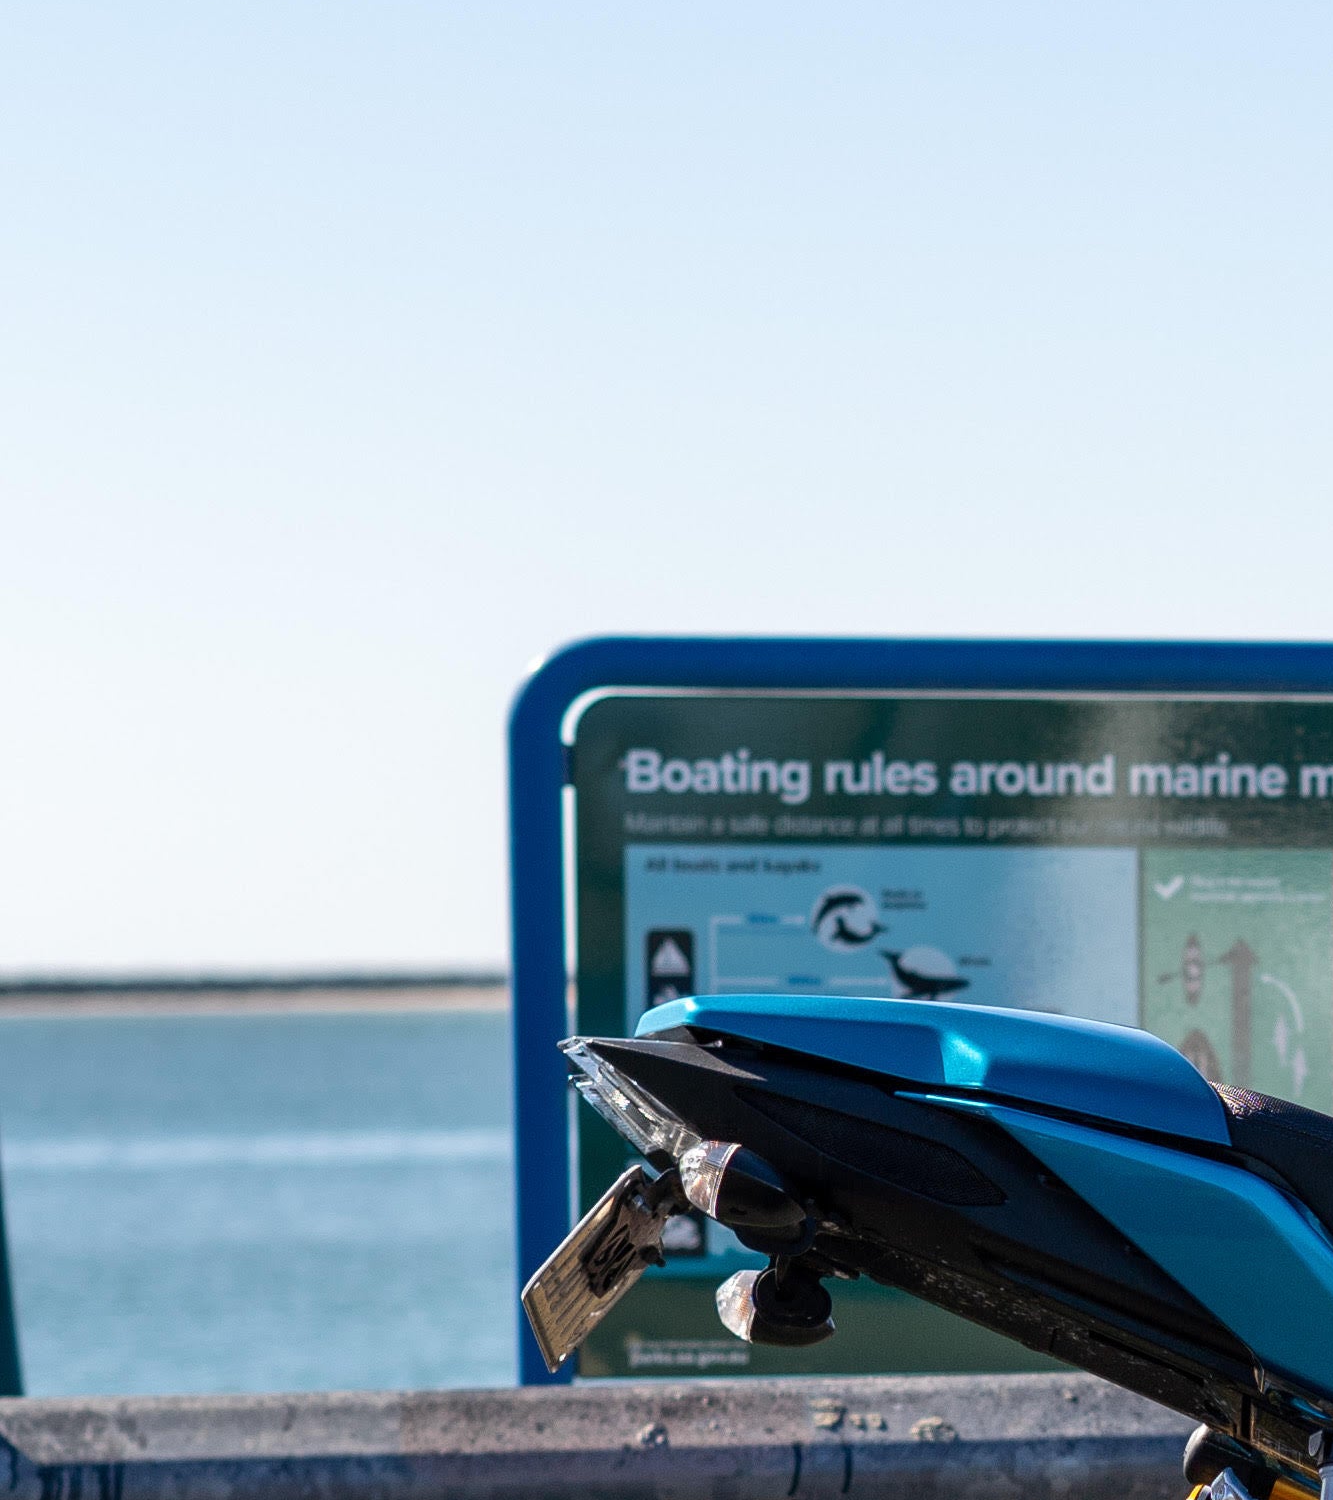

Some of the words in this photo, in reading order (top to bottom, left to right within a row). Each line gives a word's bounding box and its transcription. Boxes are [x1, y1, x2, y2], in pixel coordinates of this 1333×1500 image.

[626, 748, 811, 804] Boating
[824, 752, 938, 795] rules
[949, 753, 1115, 796] around
[1129, 754, 1288, 798] marine
